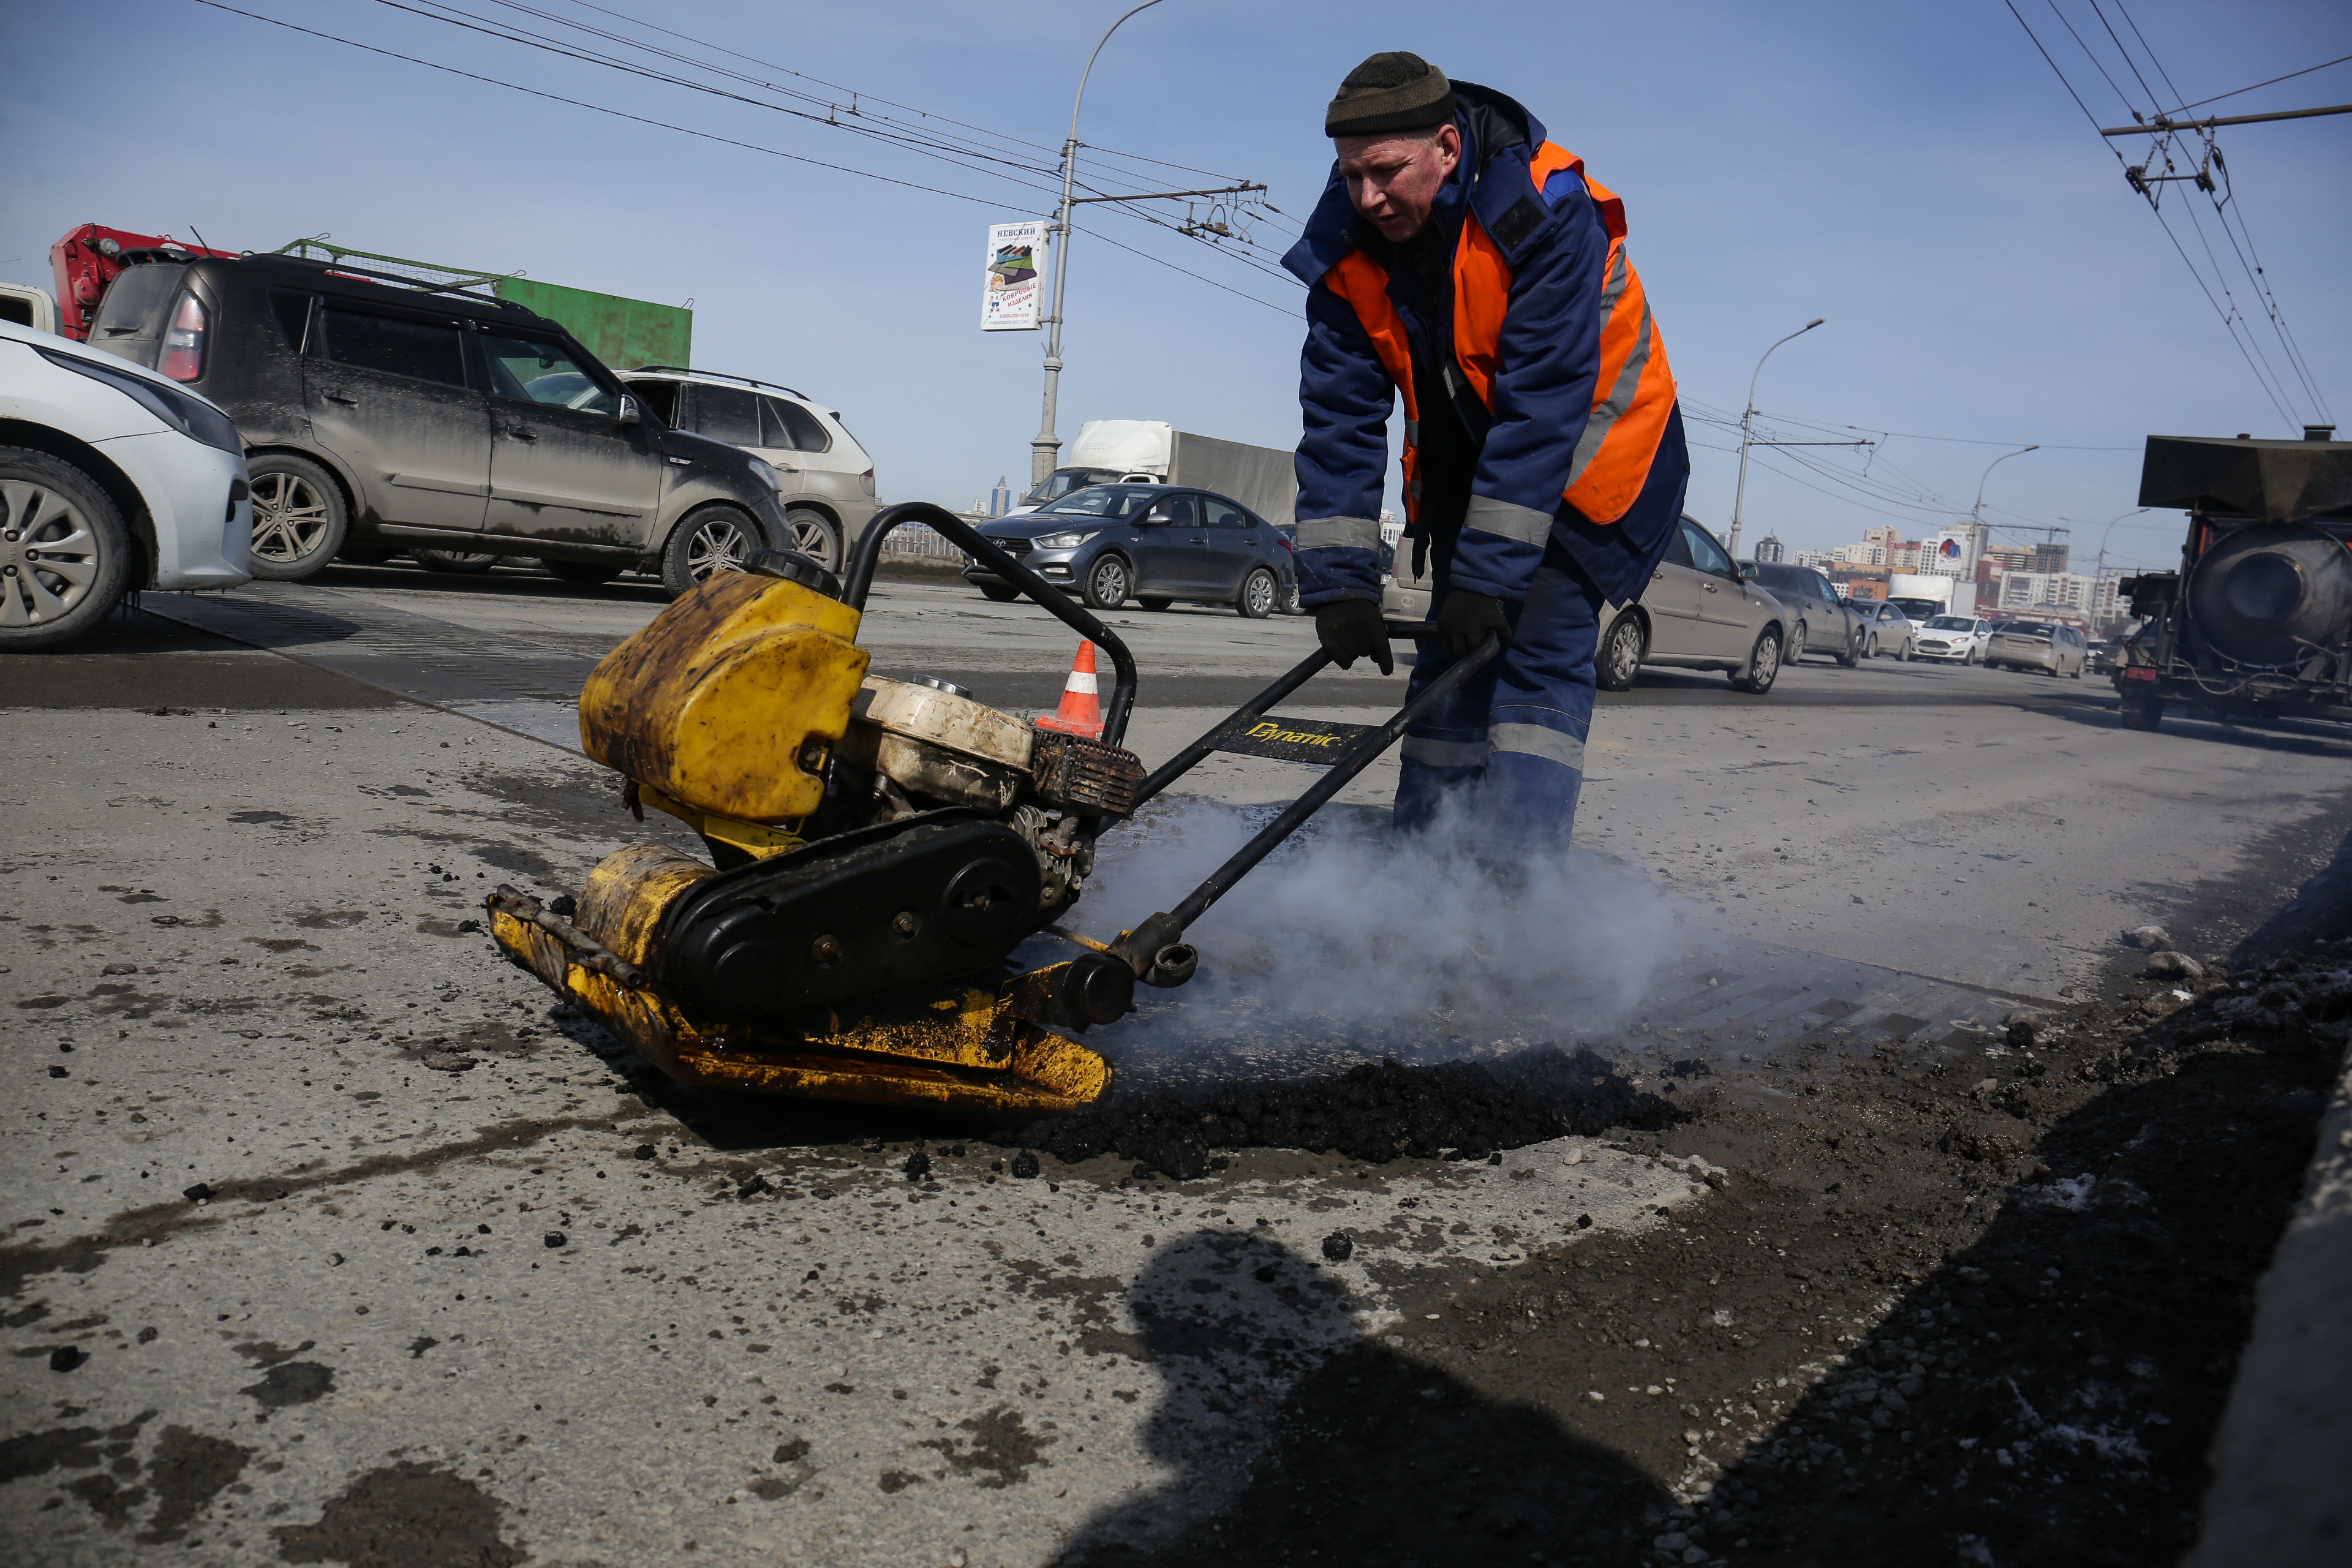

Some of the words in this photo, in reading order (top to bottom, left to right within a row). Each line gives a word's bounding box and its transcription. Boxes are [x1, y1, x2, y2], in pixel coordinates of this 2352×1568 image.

[997, 227, 1035, 237] НЕВСКИЙ
[1002, 283, 1036, 302] КОВРОВЫЕ
[1008, 293, 1033, 307] ИЗДЕЛИЯ
[1403, 596, 1413, 605] RUS
[1245, 722, 1341, 747] Dynamic
